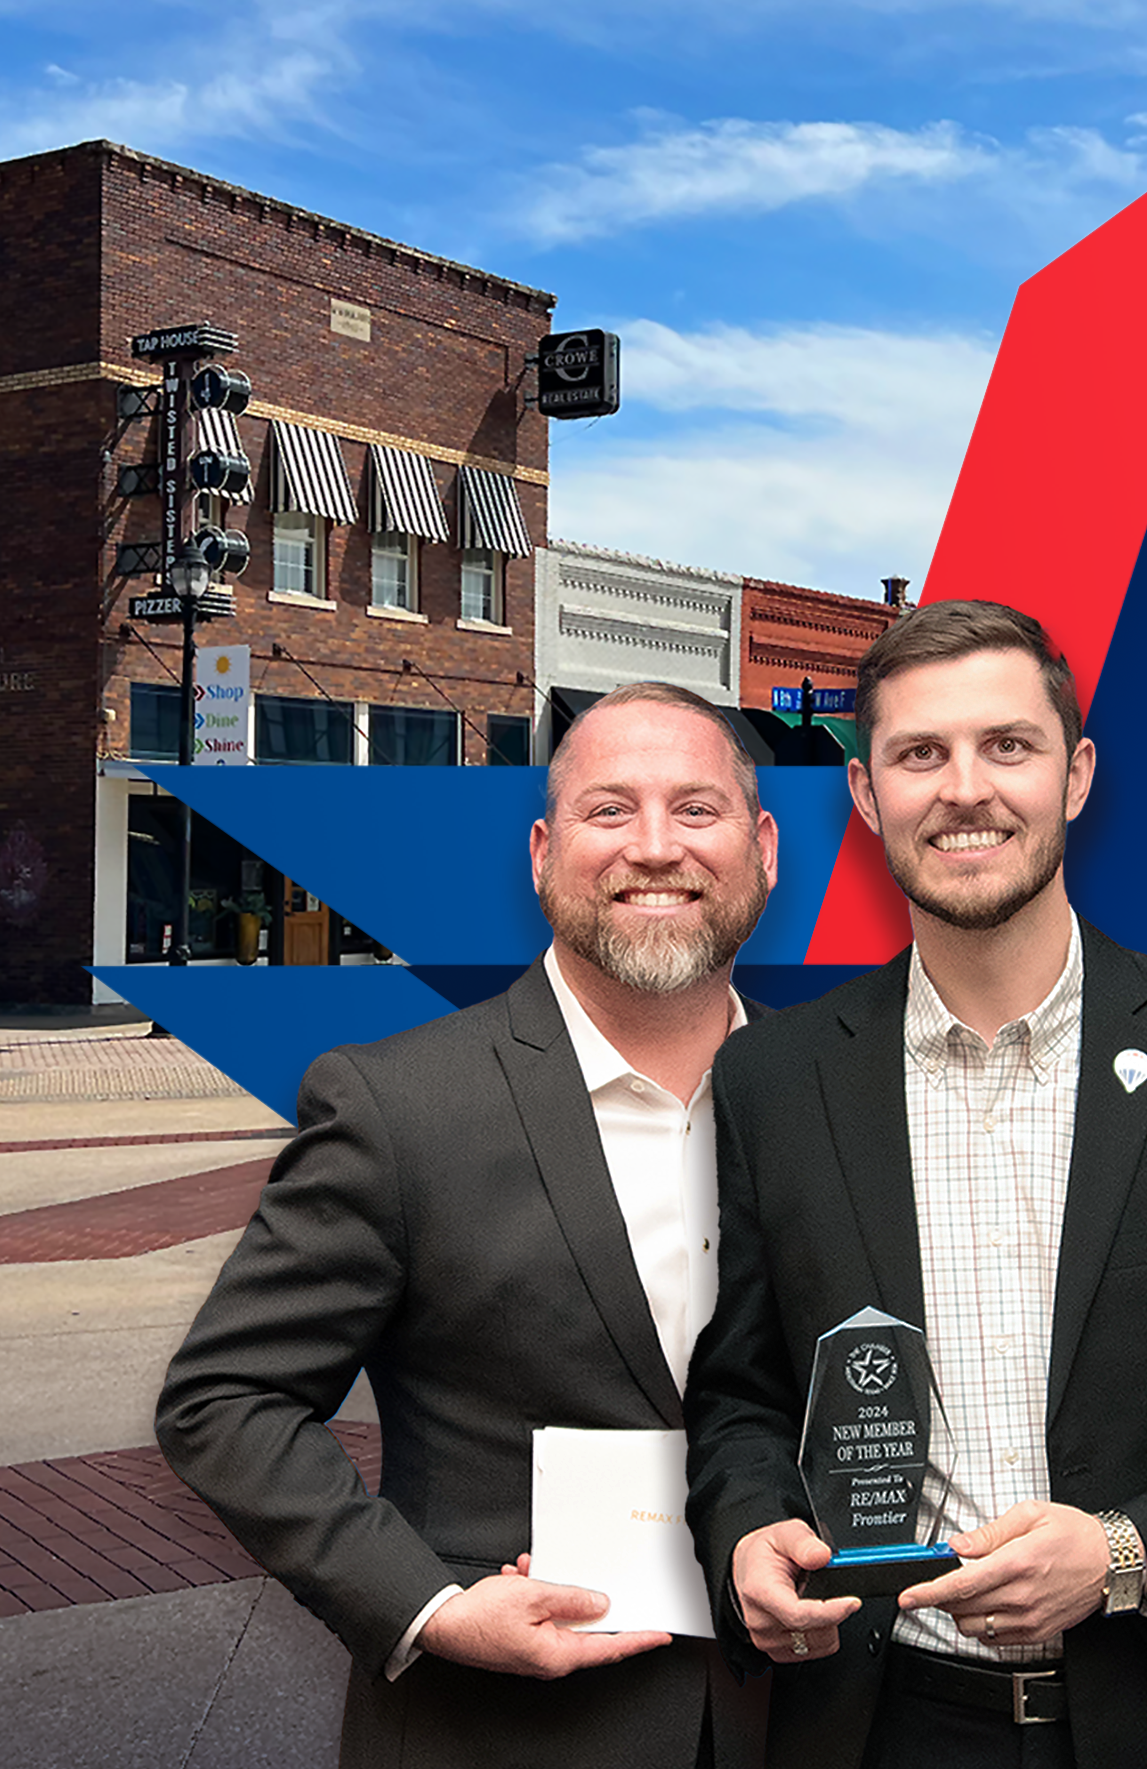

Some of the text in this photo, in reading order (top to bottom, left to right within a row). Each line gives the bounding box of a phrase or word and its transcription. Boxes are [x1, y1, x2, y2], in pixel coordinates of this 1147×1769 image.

[137, 330, 199, 352] TAP HOUSE
[544, 349, 599, 368] CROWE
[165, 361, 179, 472] TWISTED
[134, 599, 182, 616] PIZZER
[206, 684, 245, 702] Shop
[206, 713, 240, 728] Dine
[204, 738, 245, 753] Shine
[858, 1405, 890, 1419] 2024
[832, 1420, 916, 1441] NEW MEMBER
[837, 1441, 914, 1462] OF THE YEAR
[851, 1489, 906, 1507] RE/MAX
[630, 1509, 674, 1525] REMAX
[852, 1511, 908, 1527] Frontier
